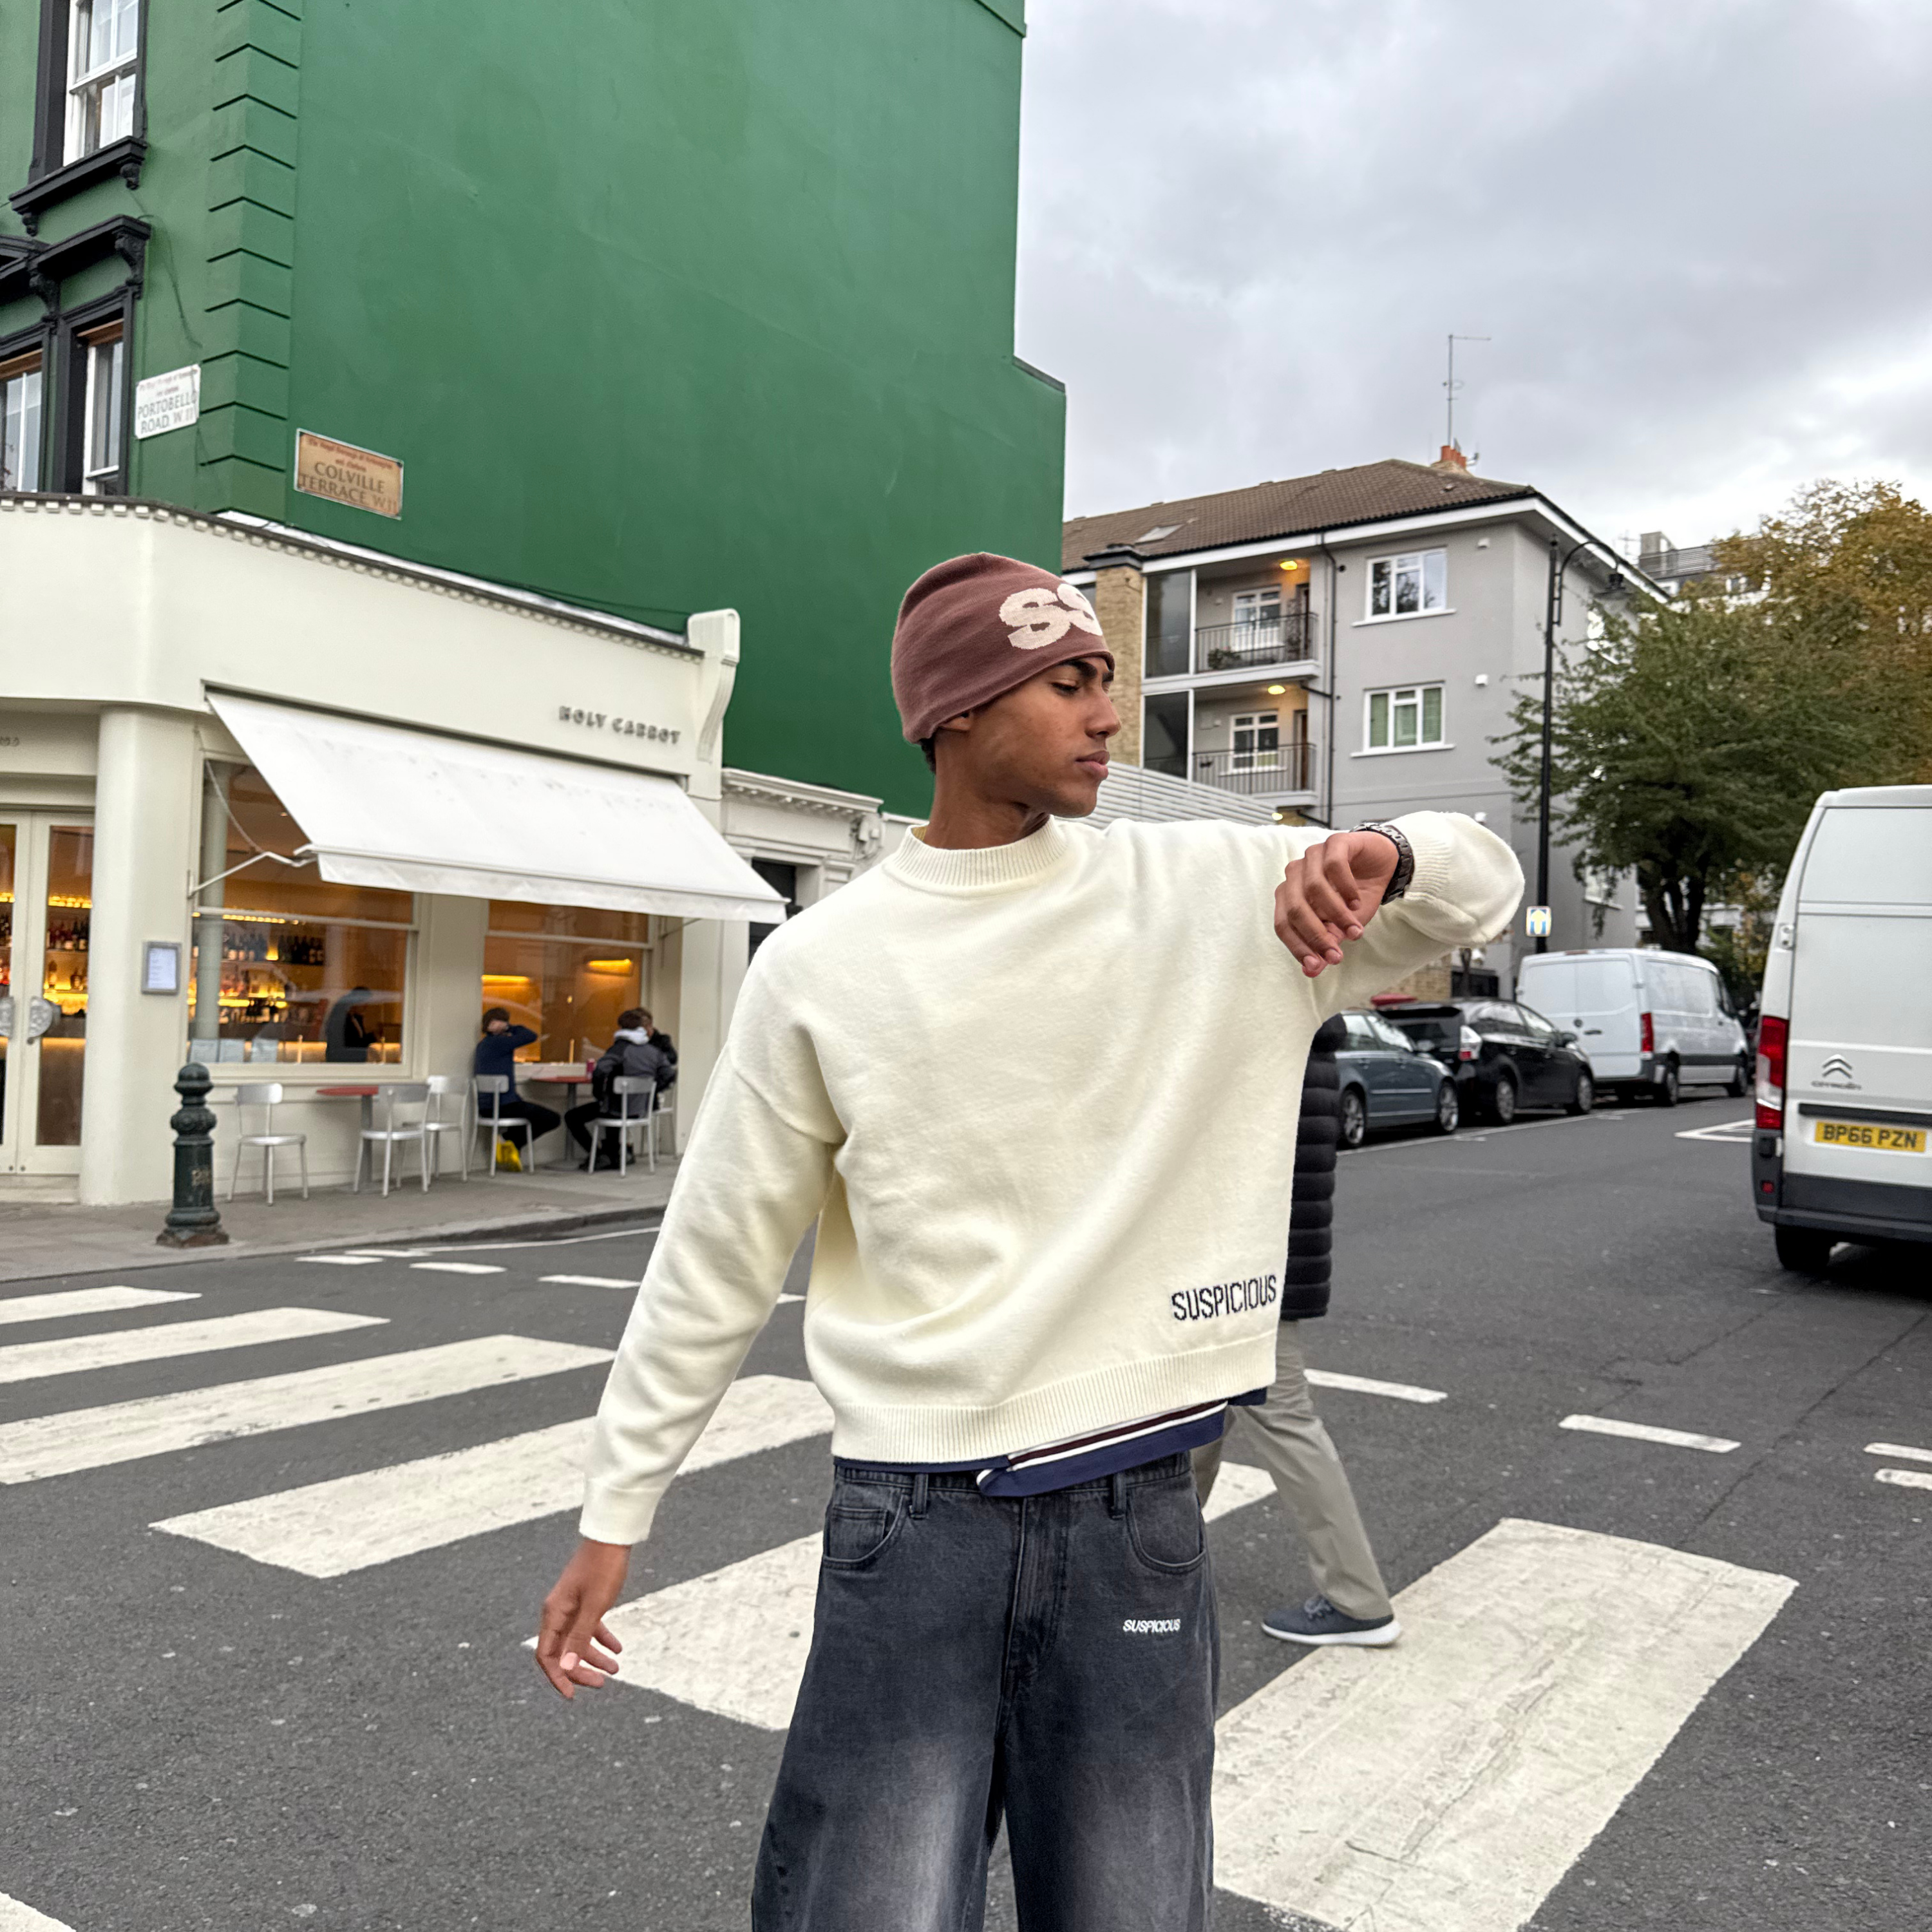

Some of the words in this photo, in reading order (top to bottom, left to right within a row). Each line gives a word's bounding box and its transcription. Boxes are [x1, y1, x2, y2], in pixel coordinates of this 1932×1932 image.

[138, 390, 197, 419] PORTOBELLO
[140, 414, 169, 434] ROAD
[299, 473, 369, 504] TERRACE
[314, 461, 386, 494] COLVILLE
[558, 705, 607, 728] HOLY
[612, 717, 681, 744] CARROT
[1823, 1123, 1872, 1144] BP66
[1877, 1130, 1917, 1149] PZN
[1171, 1274, 1277, 1320] SUSPICIOUS
[1122, 1618, 1181, 1634] SUSPICIOUS
